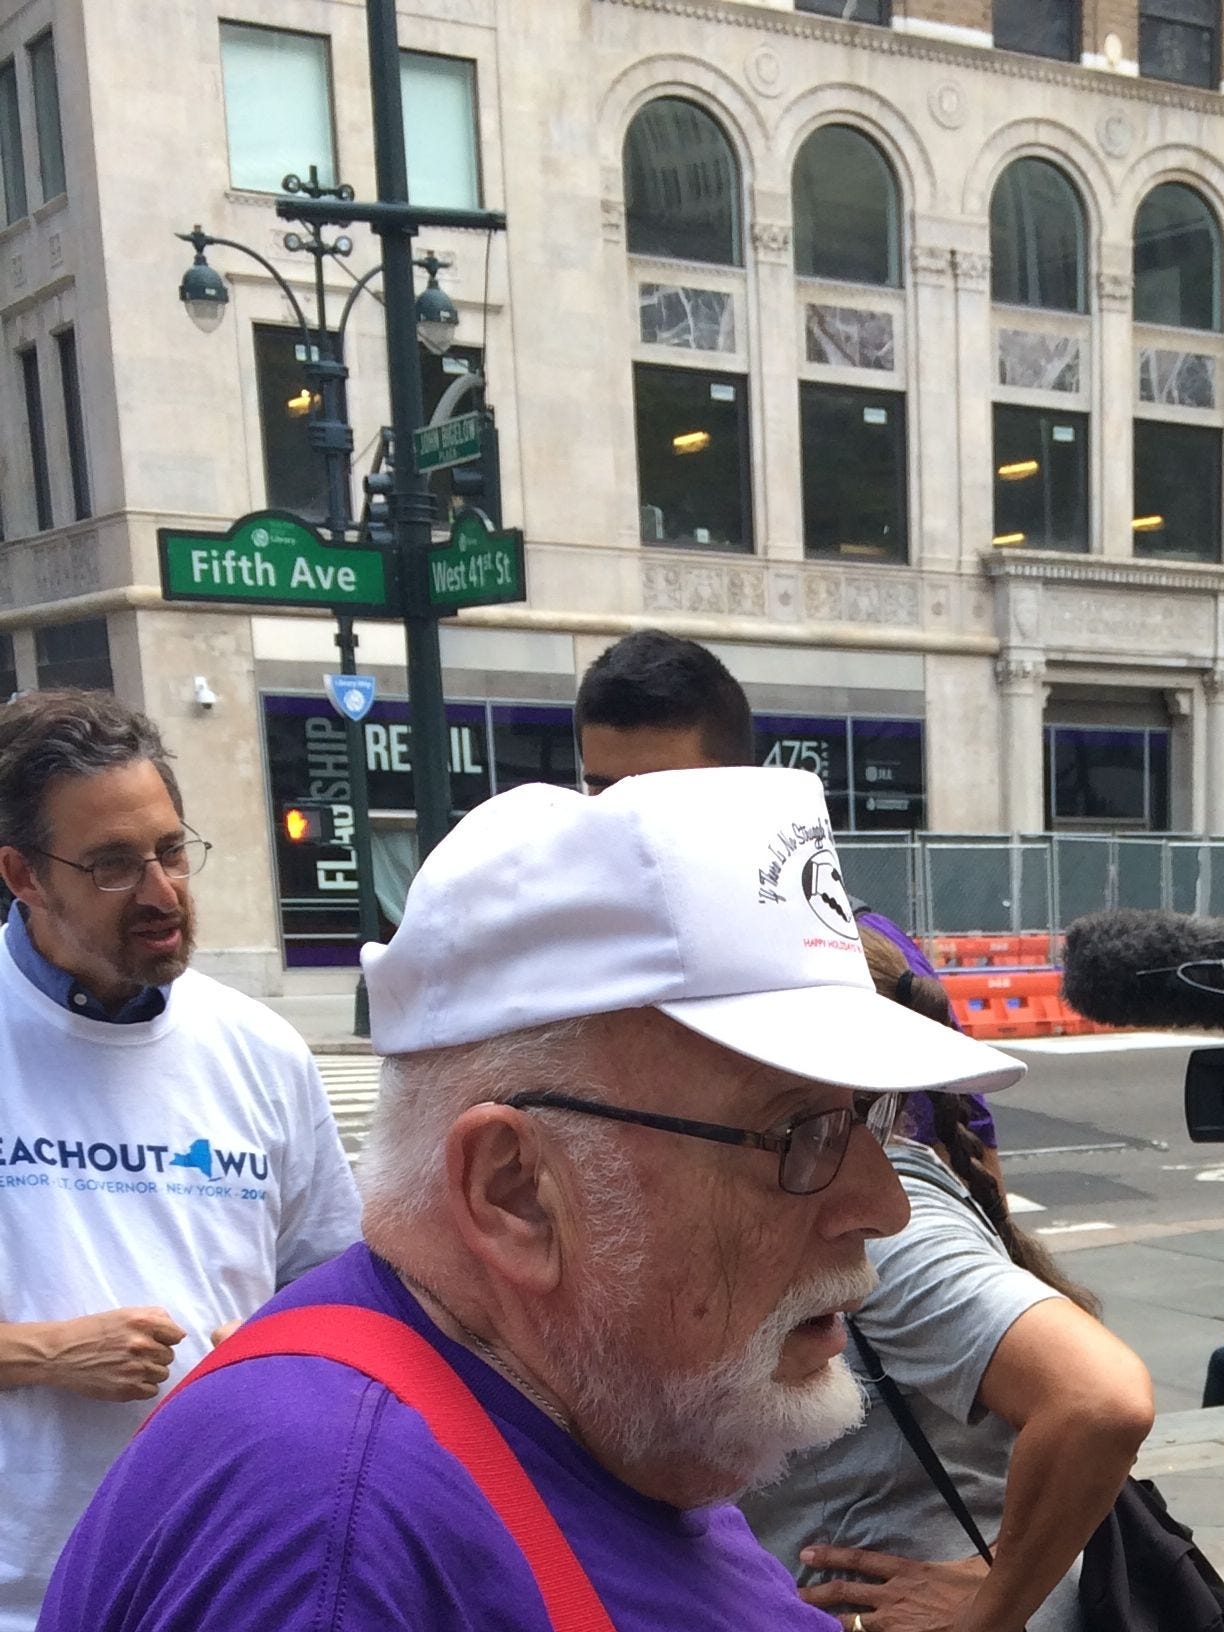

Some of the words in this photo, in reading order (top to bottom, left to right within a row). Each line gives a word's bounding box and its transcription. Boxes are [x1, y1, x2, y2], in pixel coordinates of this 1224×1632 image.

[191, 550, 276, 587] Fifth
[290, 556, 357, 592] Ave
[432, 559, 467, 594] West
[468, 552, 493, 587] 41st
[495, 550, 512, 586] St
[364, 723, 482, 774] REIL
[762, 740, 822, 776] 475
[214, 1149, 268, 1181] WU
[74, 1179, 157, 1194] GOVERNOR
[167, 1183, 193, 1195] NEW
[196, 1185, 232, 1198] YORK
